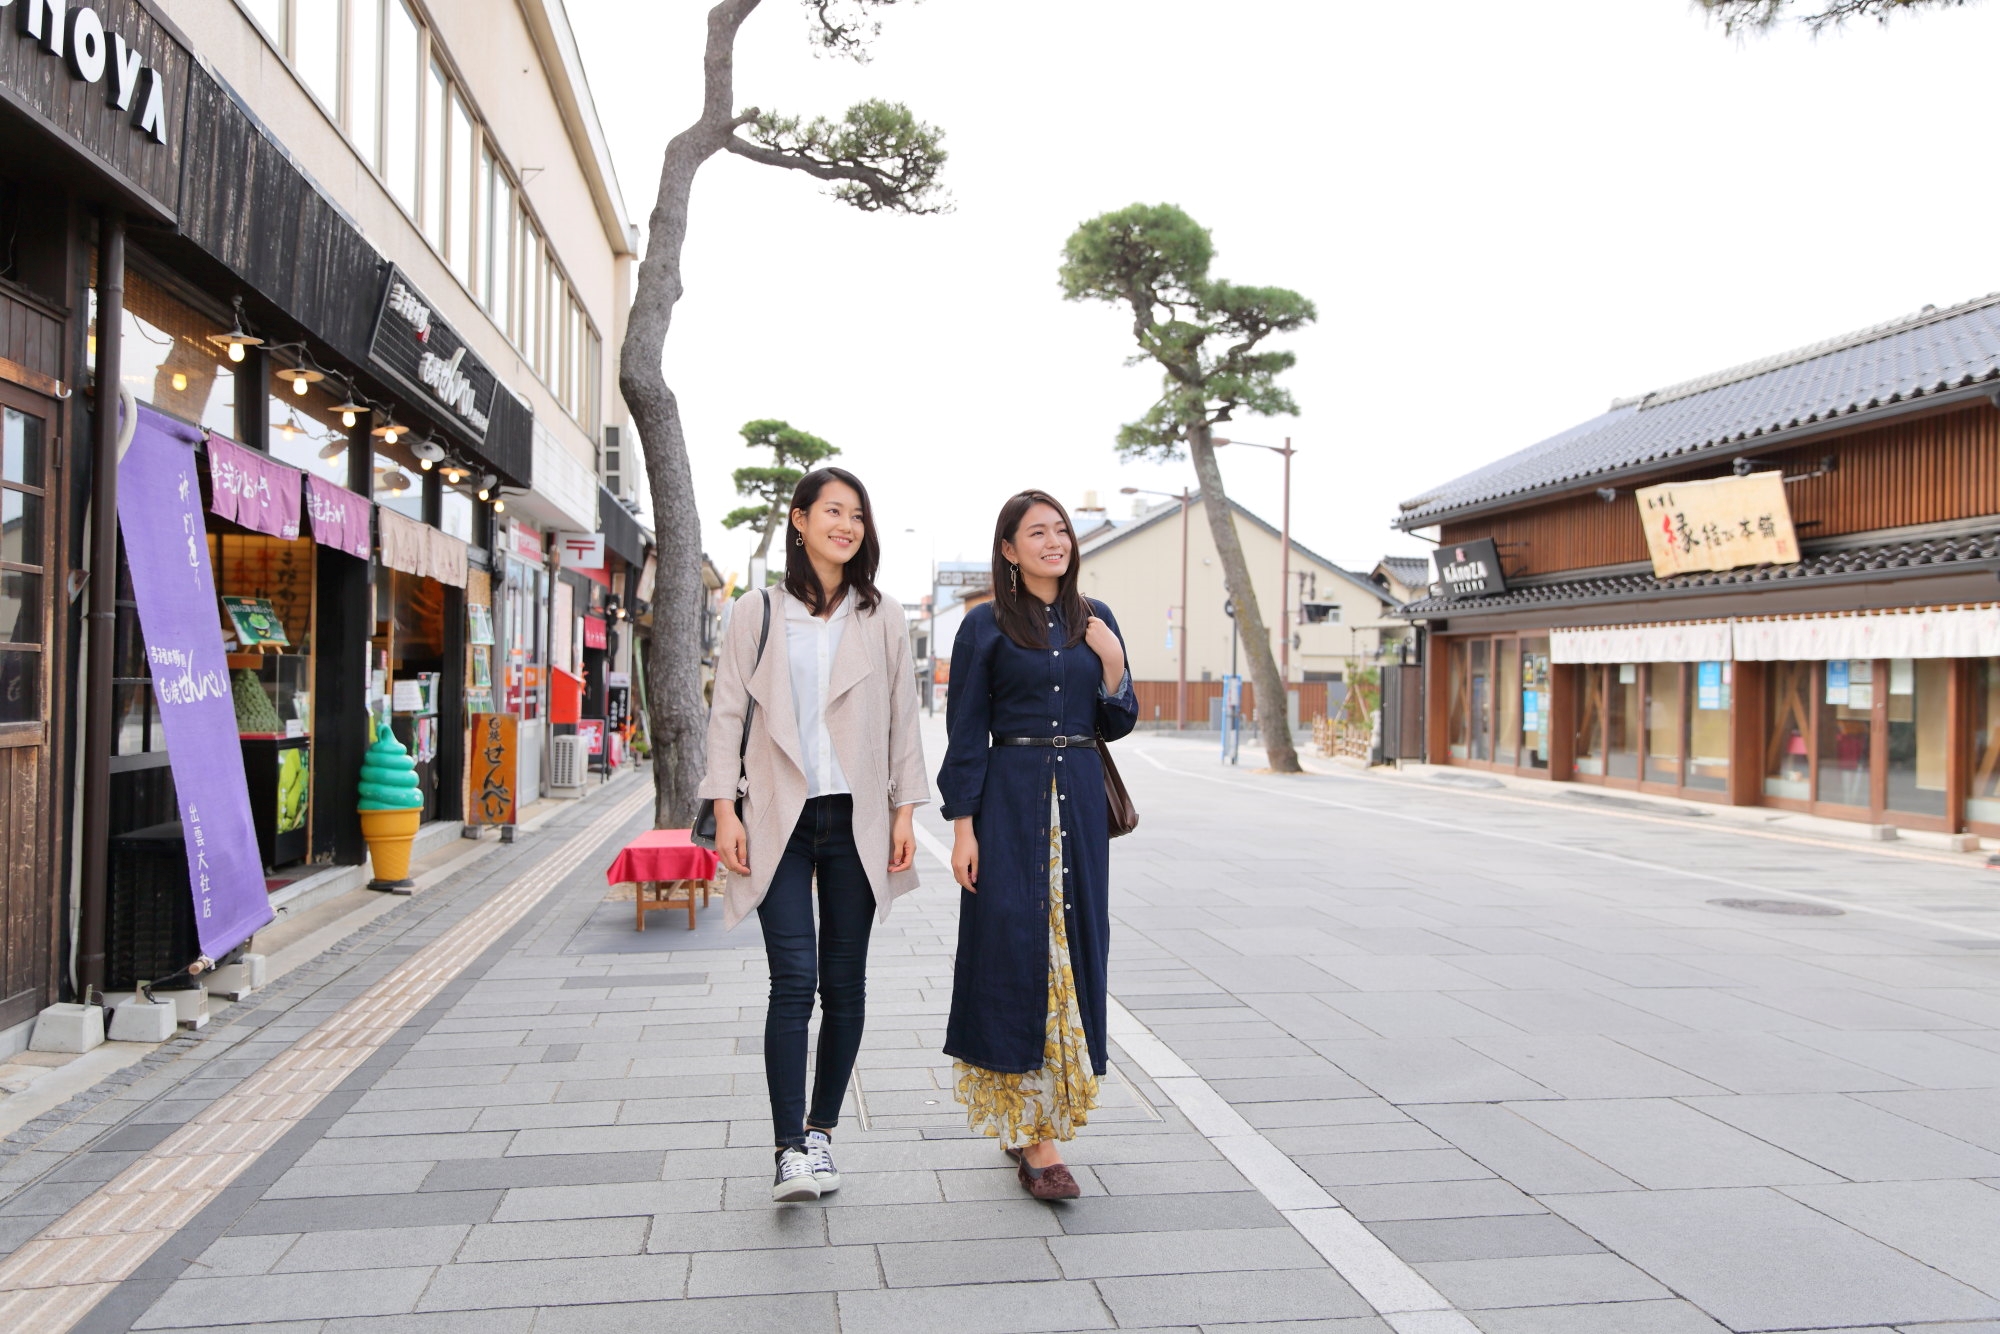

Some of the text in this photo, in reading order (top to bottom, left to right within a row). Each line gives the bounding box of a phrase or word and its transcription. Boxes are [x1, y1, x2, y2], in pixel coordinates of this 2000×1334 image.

[188, 802, 212, 919] 出雲大社店
